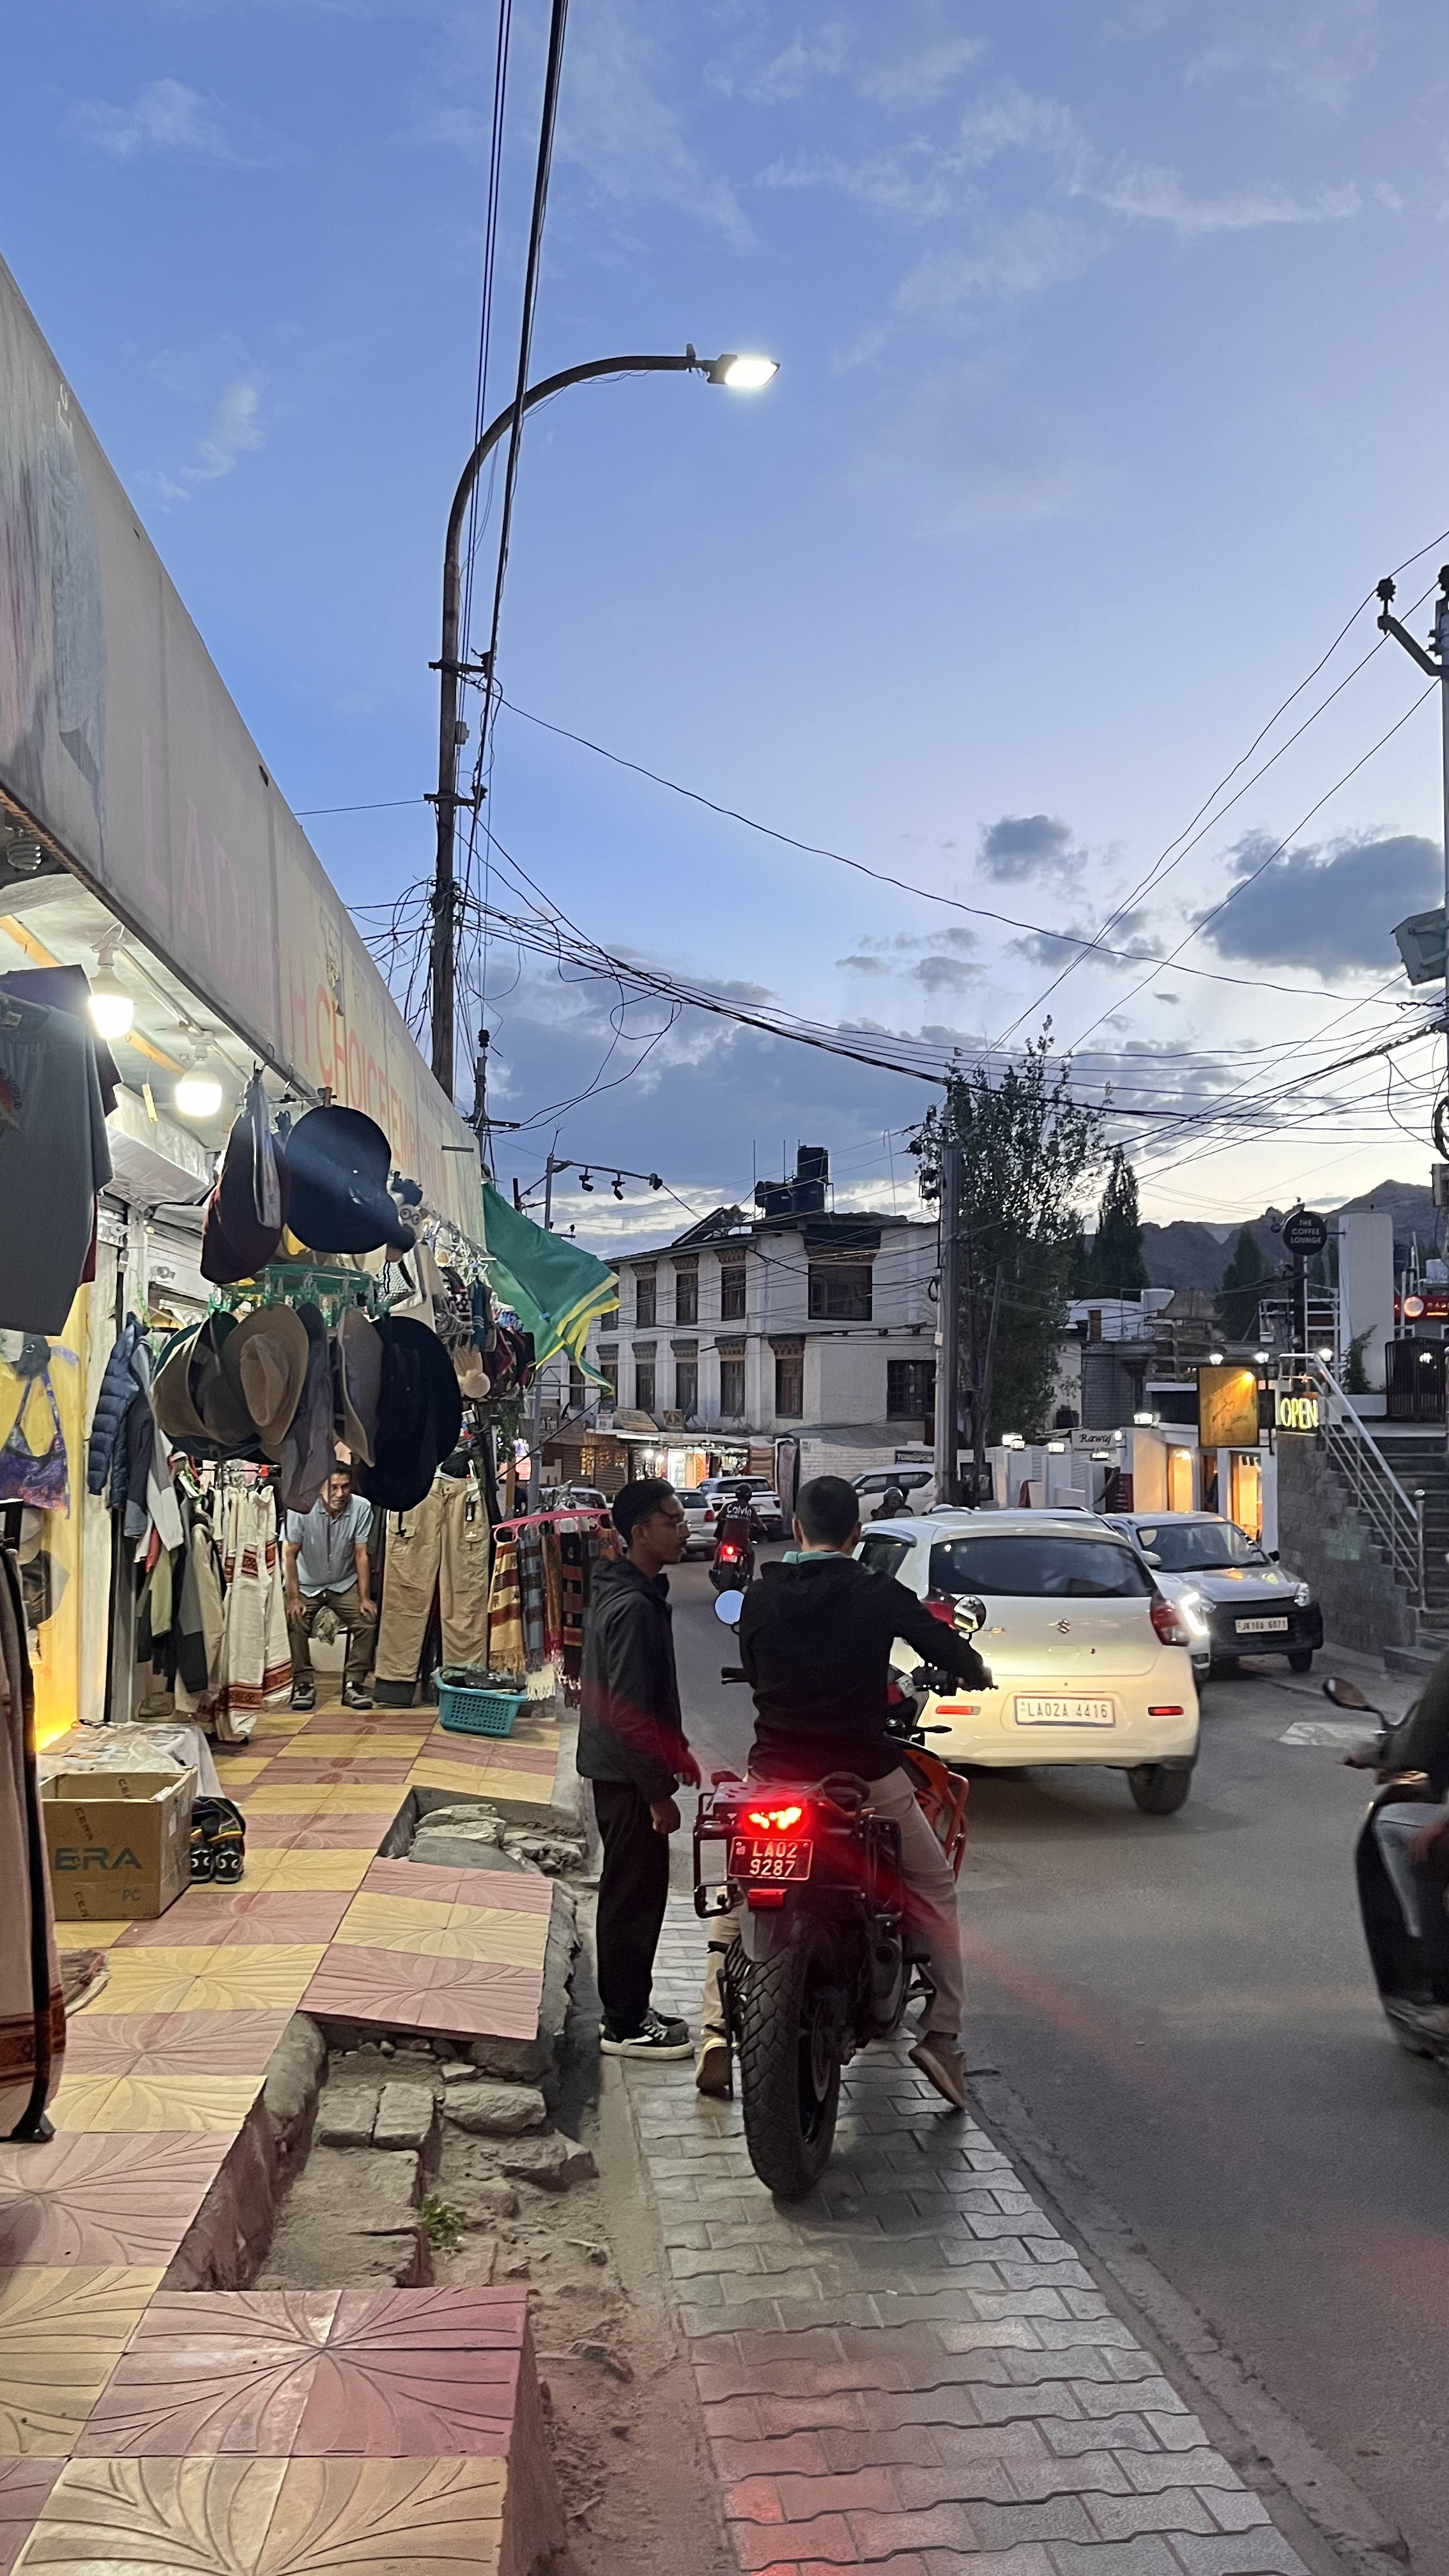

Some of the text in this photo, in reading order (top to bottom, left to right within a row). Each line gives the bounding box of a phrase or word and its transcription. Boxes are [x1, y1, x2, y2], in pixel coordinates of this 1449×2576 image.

[142, 727, 310, 1067] LADH
[316, 983, 387, 1123] CHOICE
[1280, 1397, 1319, 1429] OPEN
[727, 1504, 752, 1517] Calvin
[1027, 1702, 1068, 1717] LA02A
[1076, 1703, 1108, 1719] 4416
[752, 1841, 798, 1859] LA02
[749, 1859, 796, 1877] 9287
